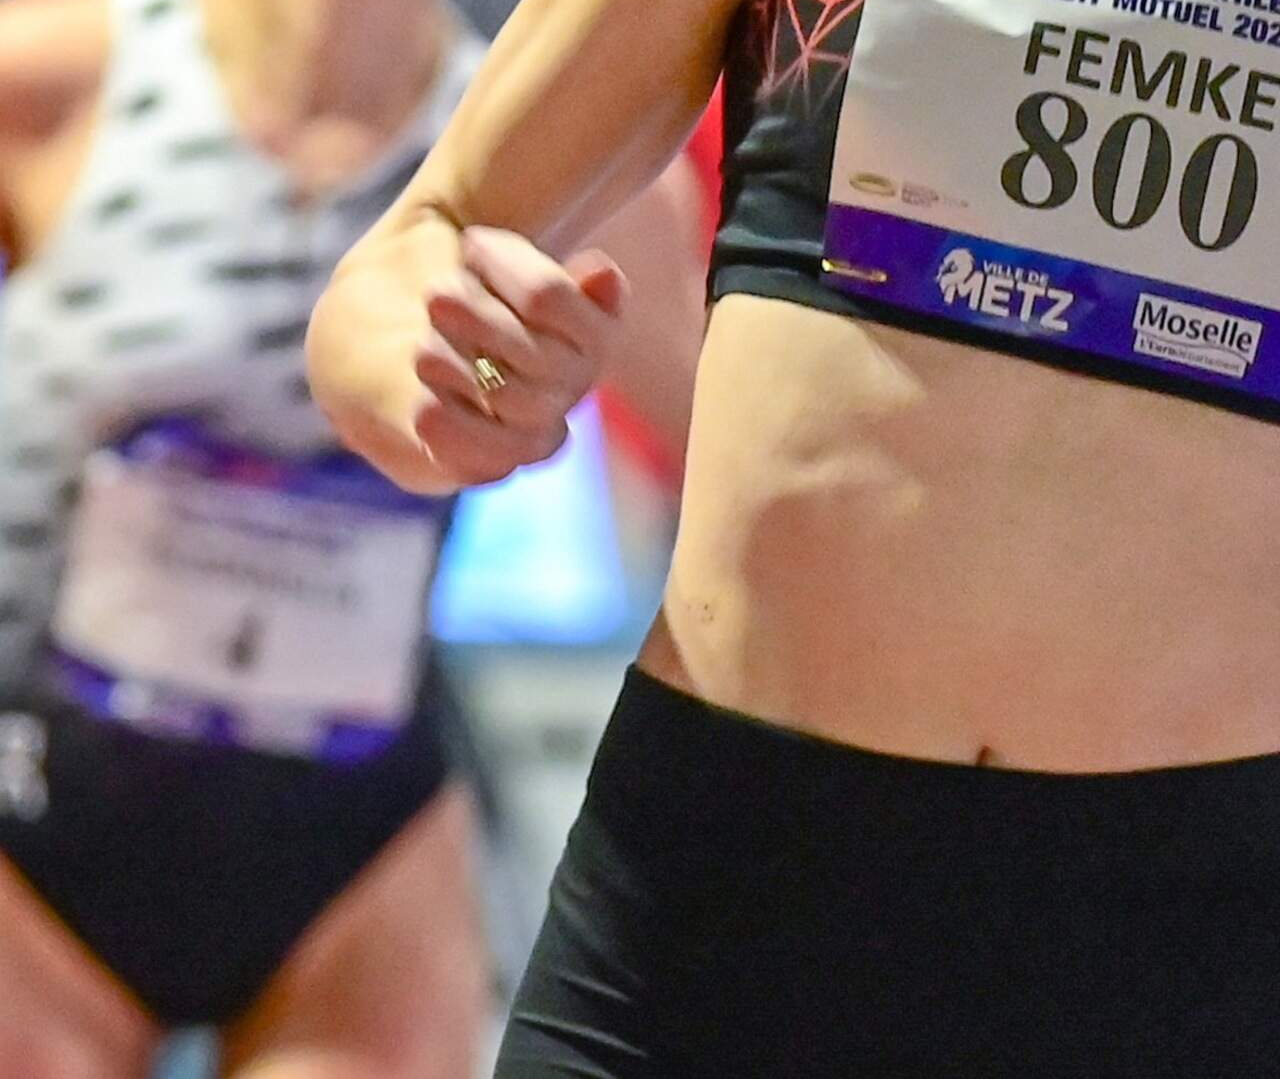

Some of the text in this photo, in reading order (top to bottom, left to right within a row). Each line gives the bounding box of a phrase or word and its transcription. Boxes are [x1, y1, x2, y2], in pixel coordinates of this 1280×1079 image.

[1001, 91, 1258, 251] 800
[942, 271, 1074, 332] METZ
[983, 260, 1049, 287] VILLE DE
[1139, 300, 1253, 353] Moselle
